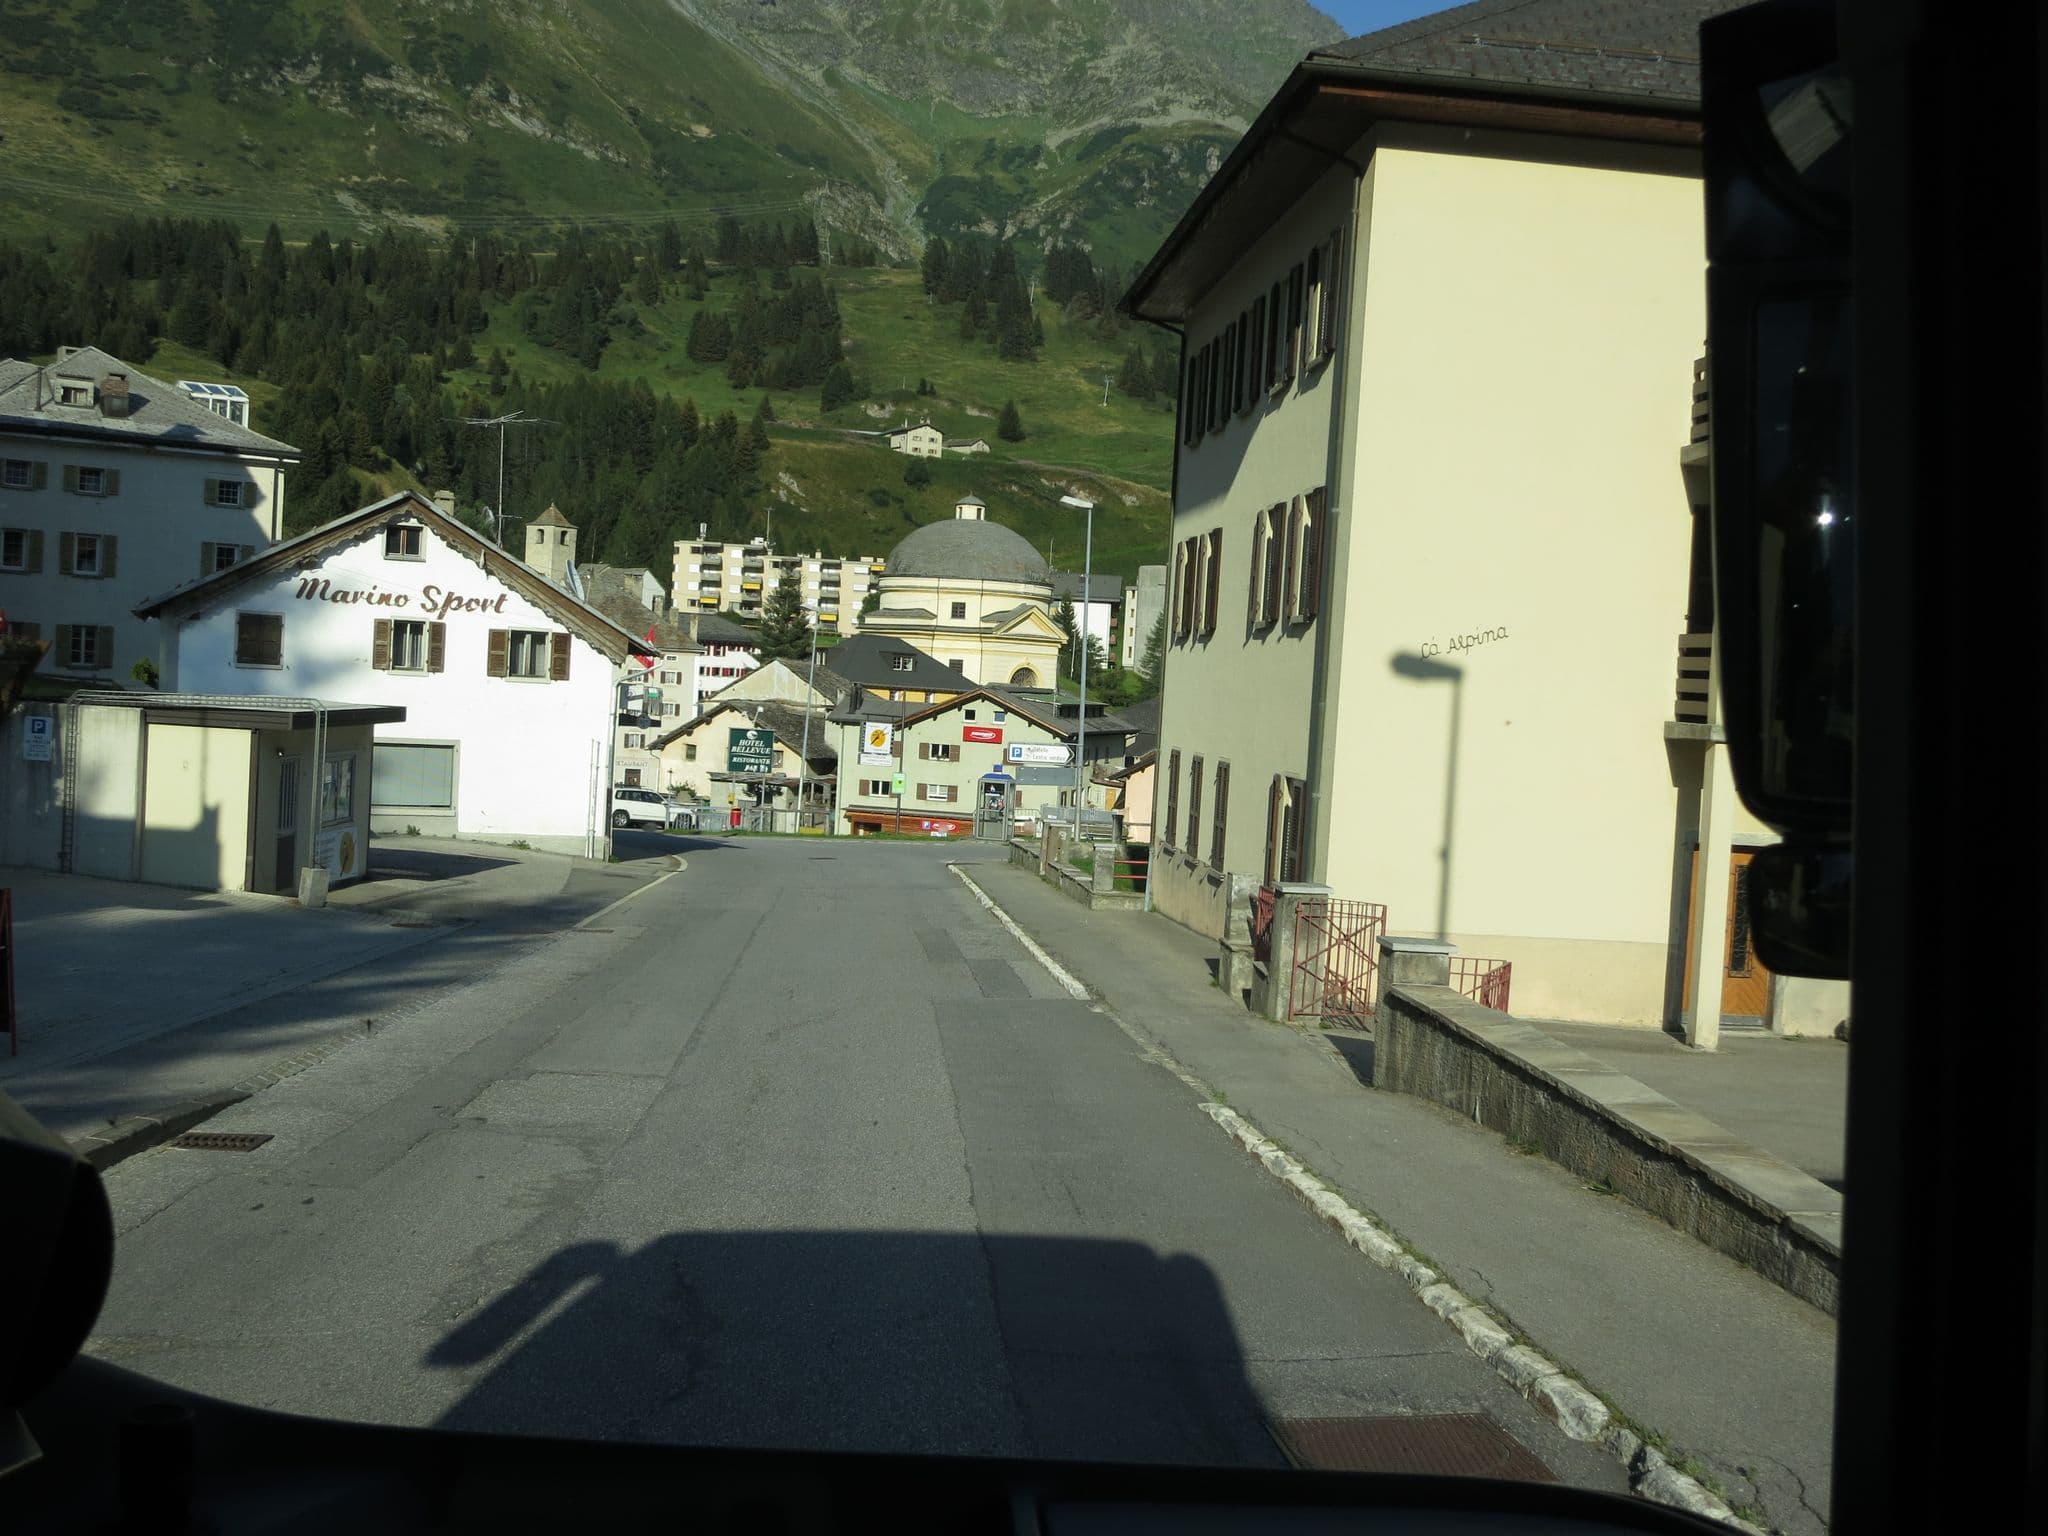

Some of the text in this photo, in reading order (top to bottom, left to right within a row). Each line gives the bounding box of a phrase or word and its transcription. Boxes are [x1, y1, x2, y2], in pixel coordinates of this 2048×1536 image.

[295, 577, 508, 620] Marino Sport
[1447, 626, 1510, 656] Alpina
[739, 739, 765, 747] HOTEL
[731, 746, 771, 754] BELLEVUE
[1014, 748, 1021, 757] P
